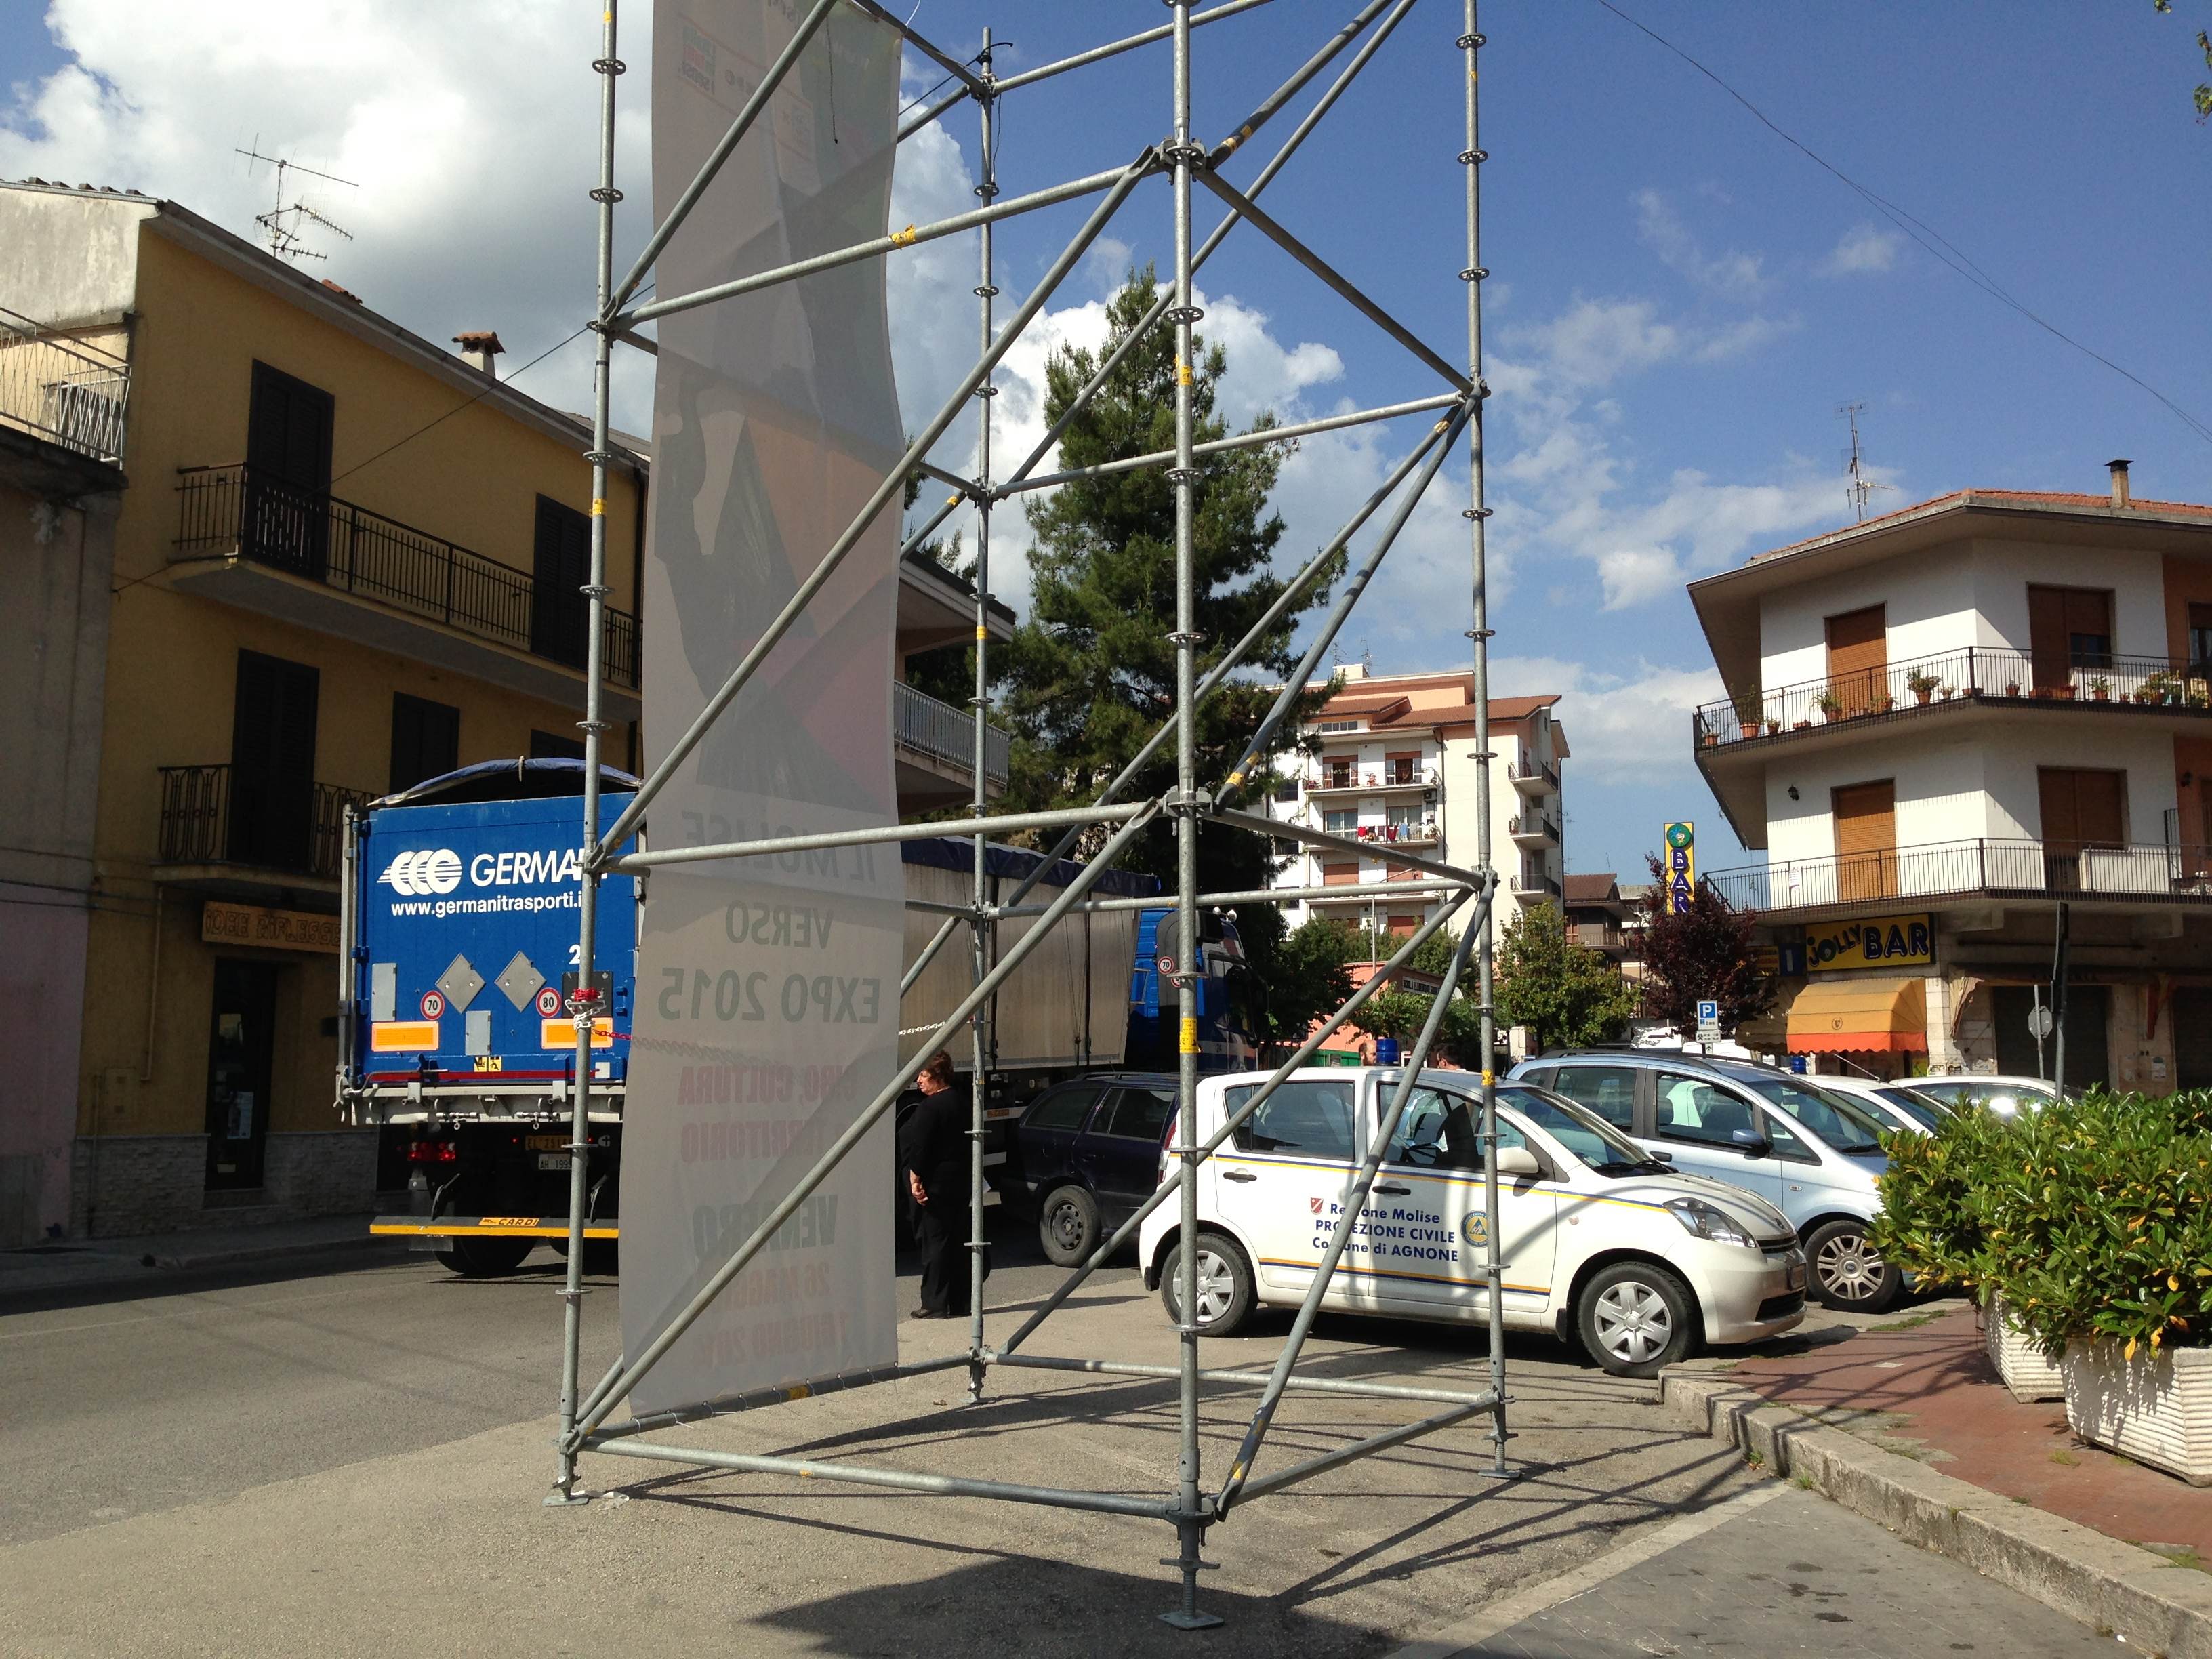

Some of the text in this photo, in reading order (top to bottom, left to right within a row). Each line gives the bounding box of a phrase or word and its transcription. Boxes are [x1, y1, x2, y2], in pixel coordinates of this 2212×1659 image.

[470, 848, 609, 886] GERMA
[1671, 847, 1691, 914] BAR
[392, 890, 582, 918] www.germanitrasporti.i
[1864, 922, 1929, 960] BAR
[428, 1000, 438, 1011] 70
[543, 997, 554, 1008] 80
[1702, 1004, 1713, 1017] P
[1330, 1203, 1440, 1223] Reone Molise
[1316, 1219, 1405, 1239] PROEZIONE
[1410, 1228, 1455, 1243] CIVILE
[1313, 1237, 1458, 1262] Coune di AGNONE
